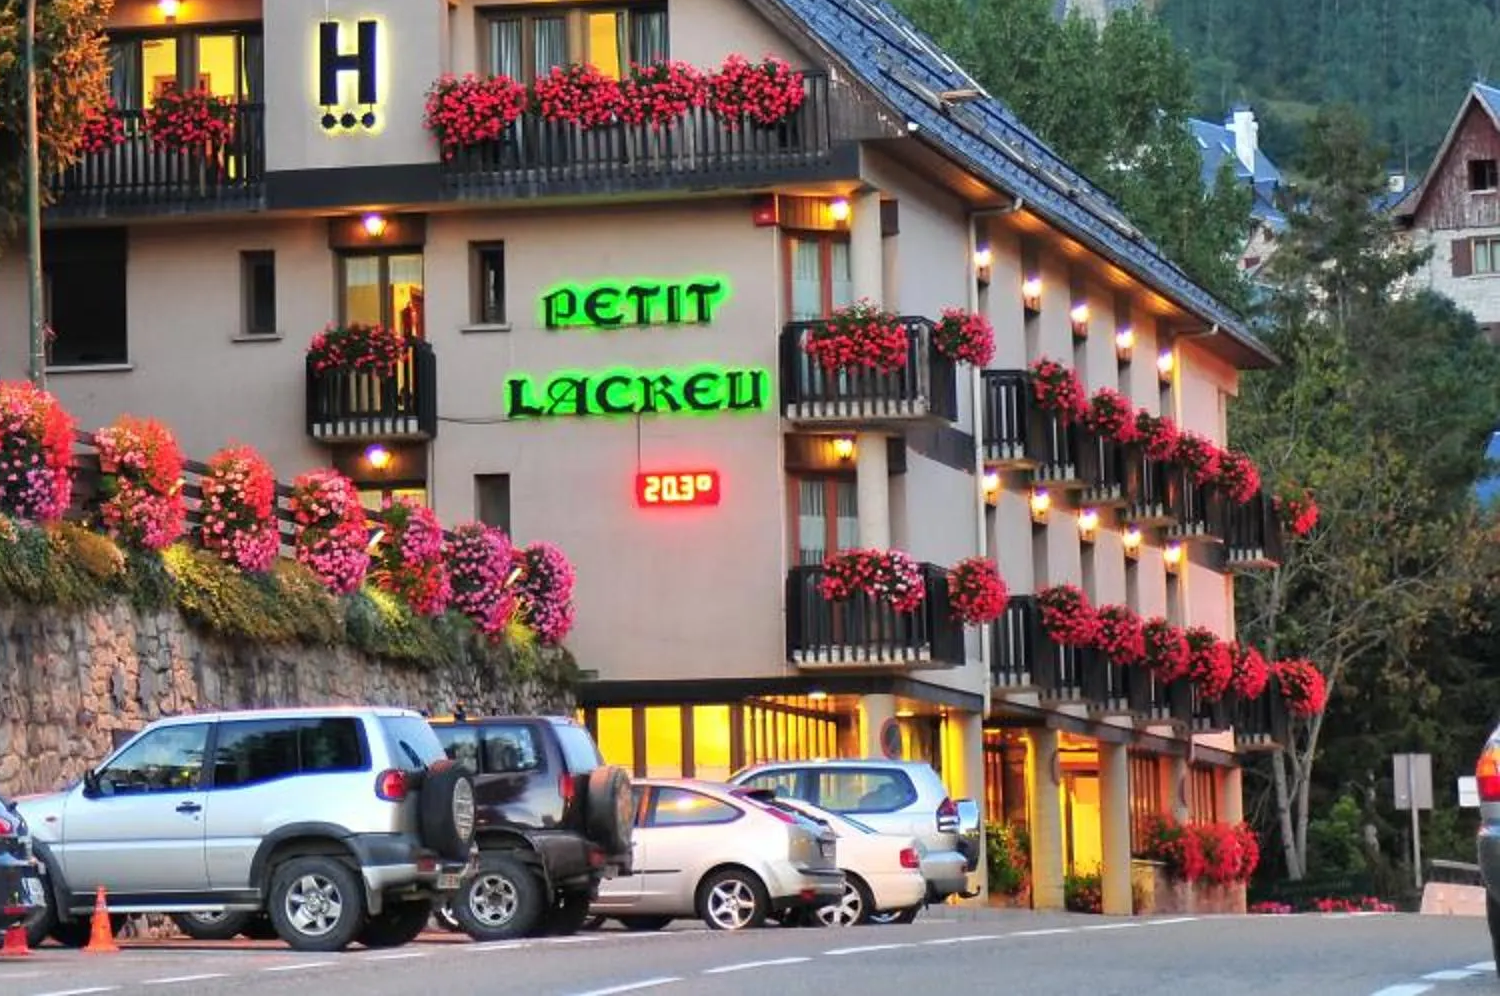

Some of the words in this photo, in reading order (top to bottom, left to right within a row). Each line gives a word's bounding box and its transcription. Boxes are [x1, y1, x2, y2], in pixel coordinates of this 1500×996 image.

[320, 21, 376, 105] H
[542, 281, 720, 328] PETIT
[508, 371, 763, 417] LACREU
